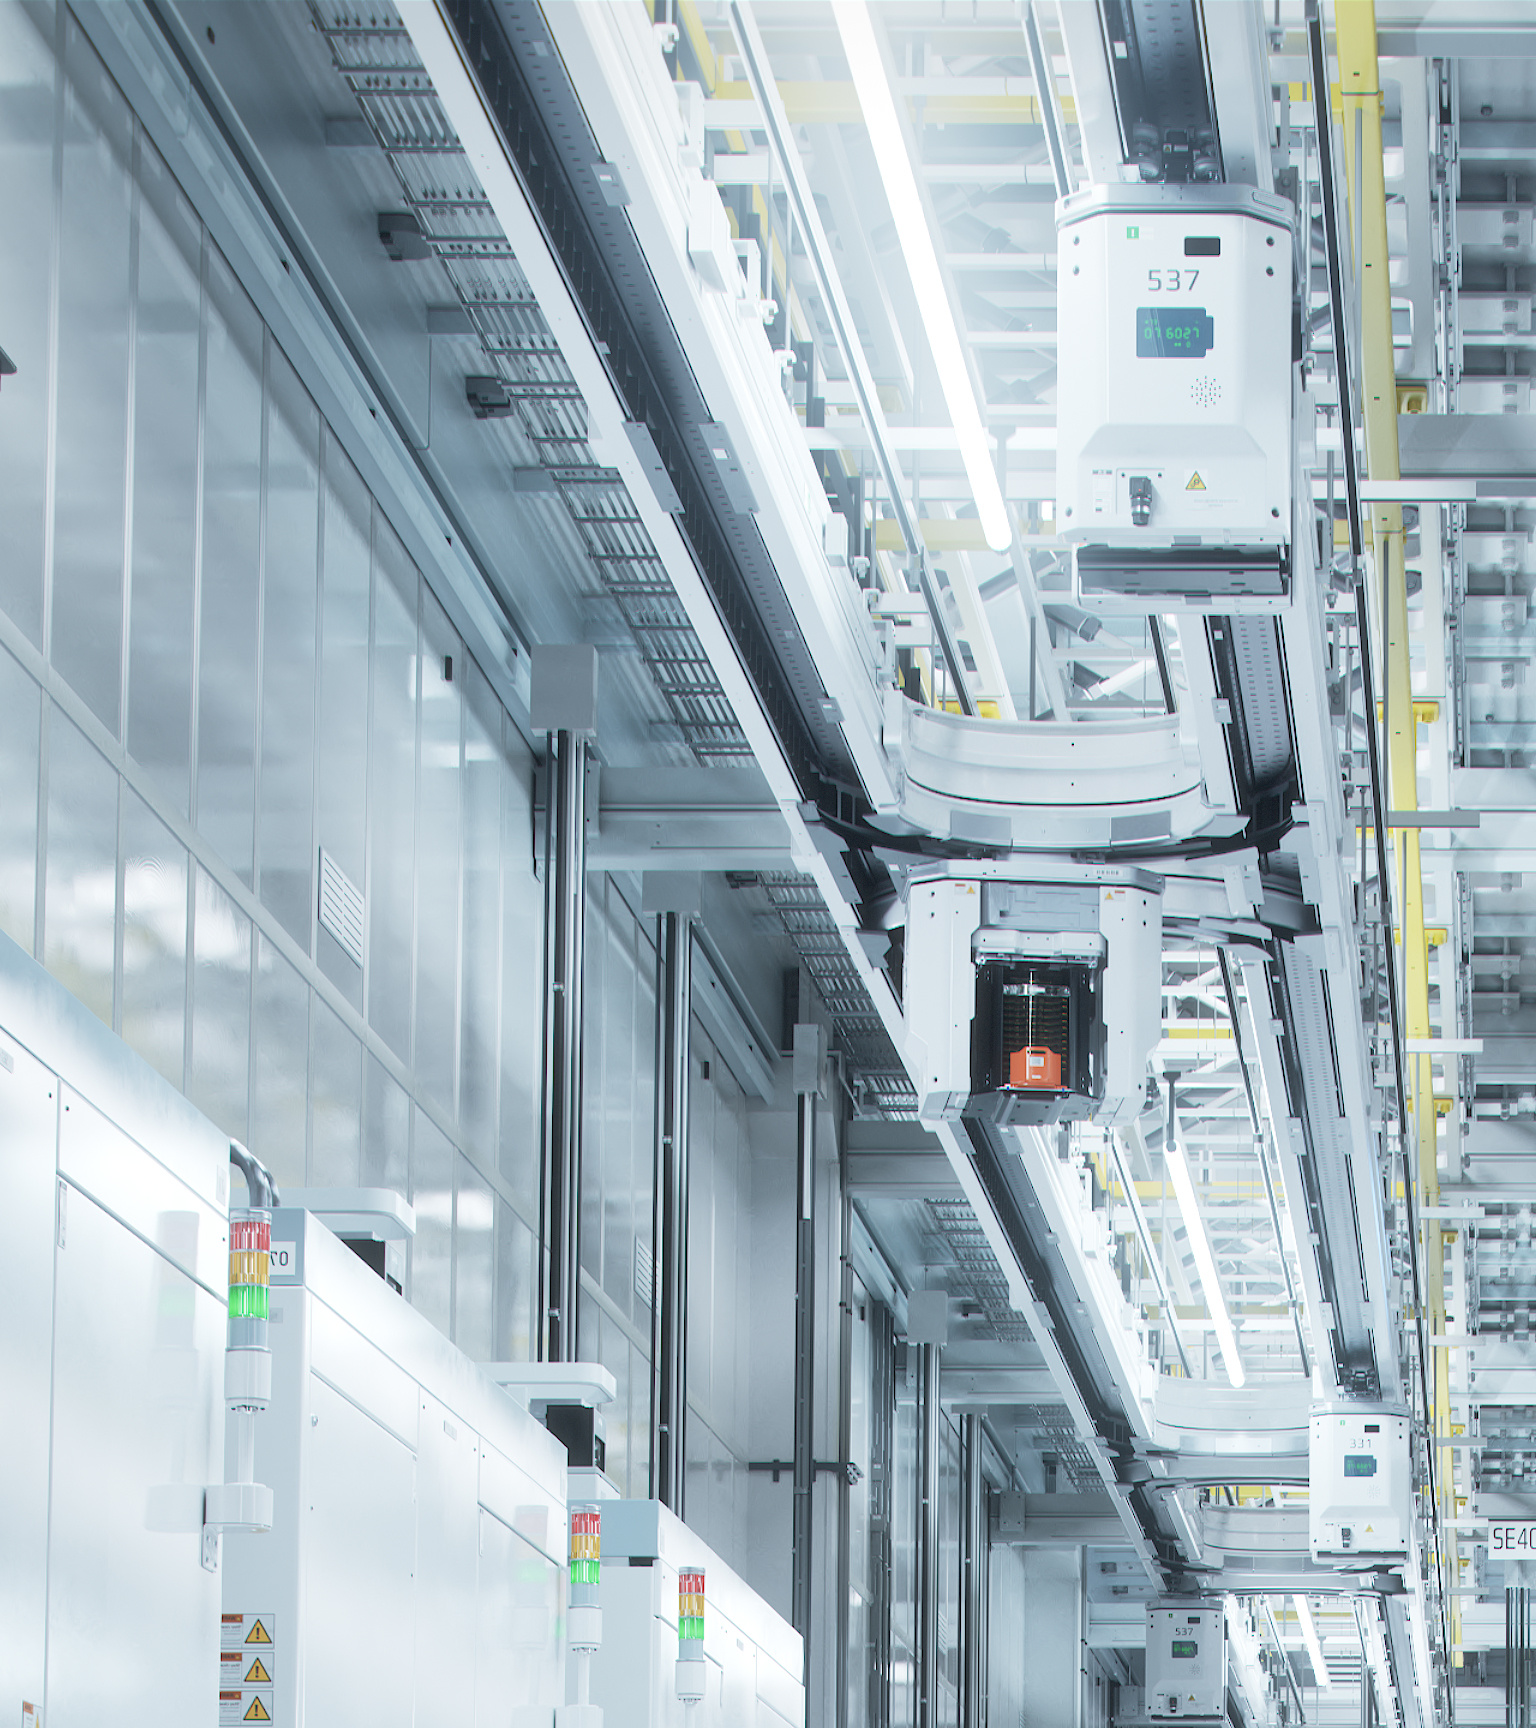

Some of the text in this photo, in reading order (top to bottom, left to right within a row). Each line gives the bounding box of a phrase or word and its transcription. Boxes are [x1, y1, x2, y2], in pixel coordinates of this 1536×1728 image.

[1147, 269, 1199, 291] 537
[1349, 1439, 1371, 1448] 331
[1175, 1627, 1194, 1636] 537
